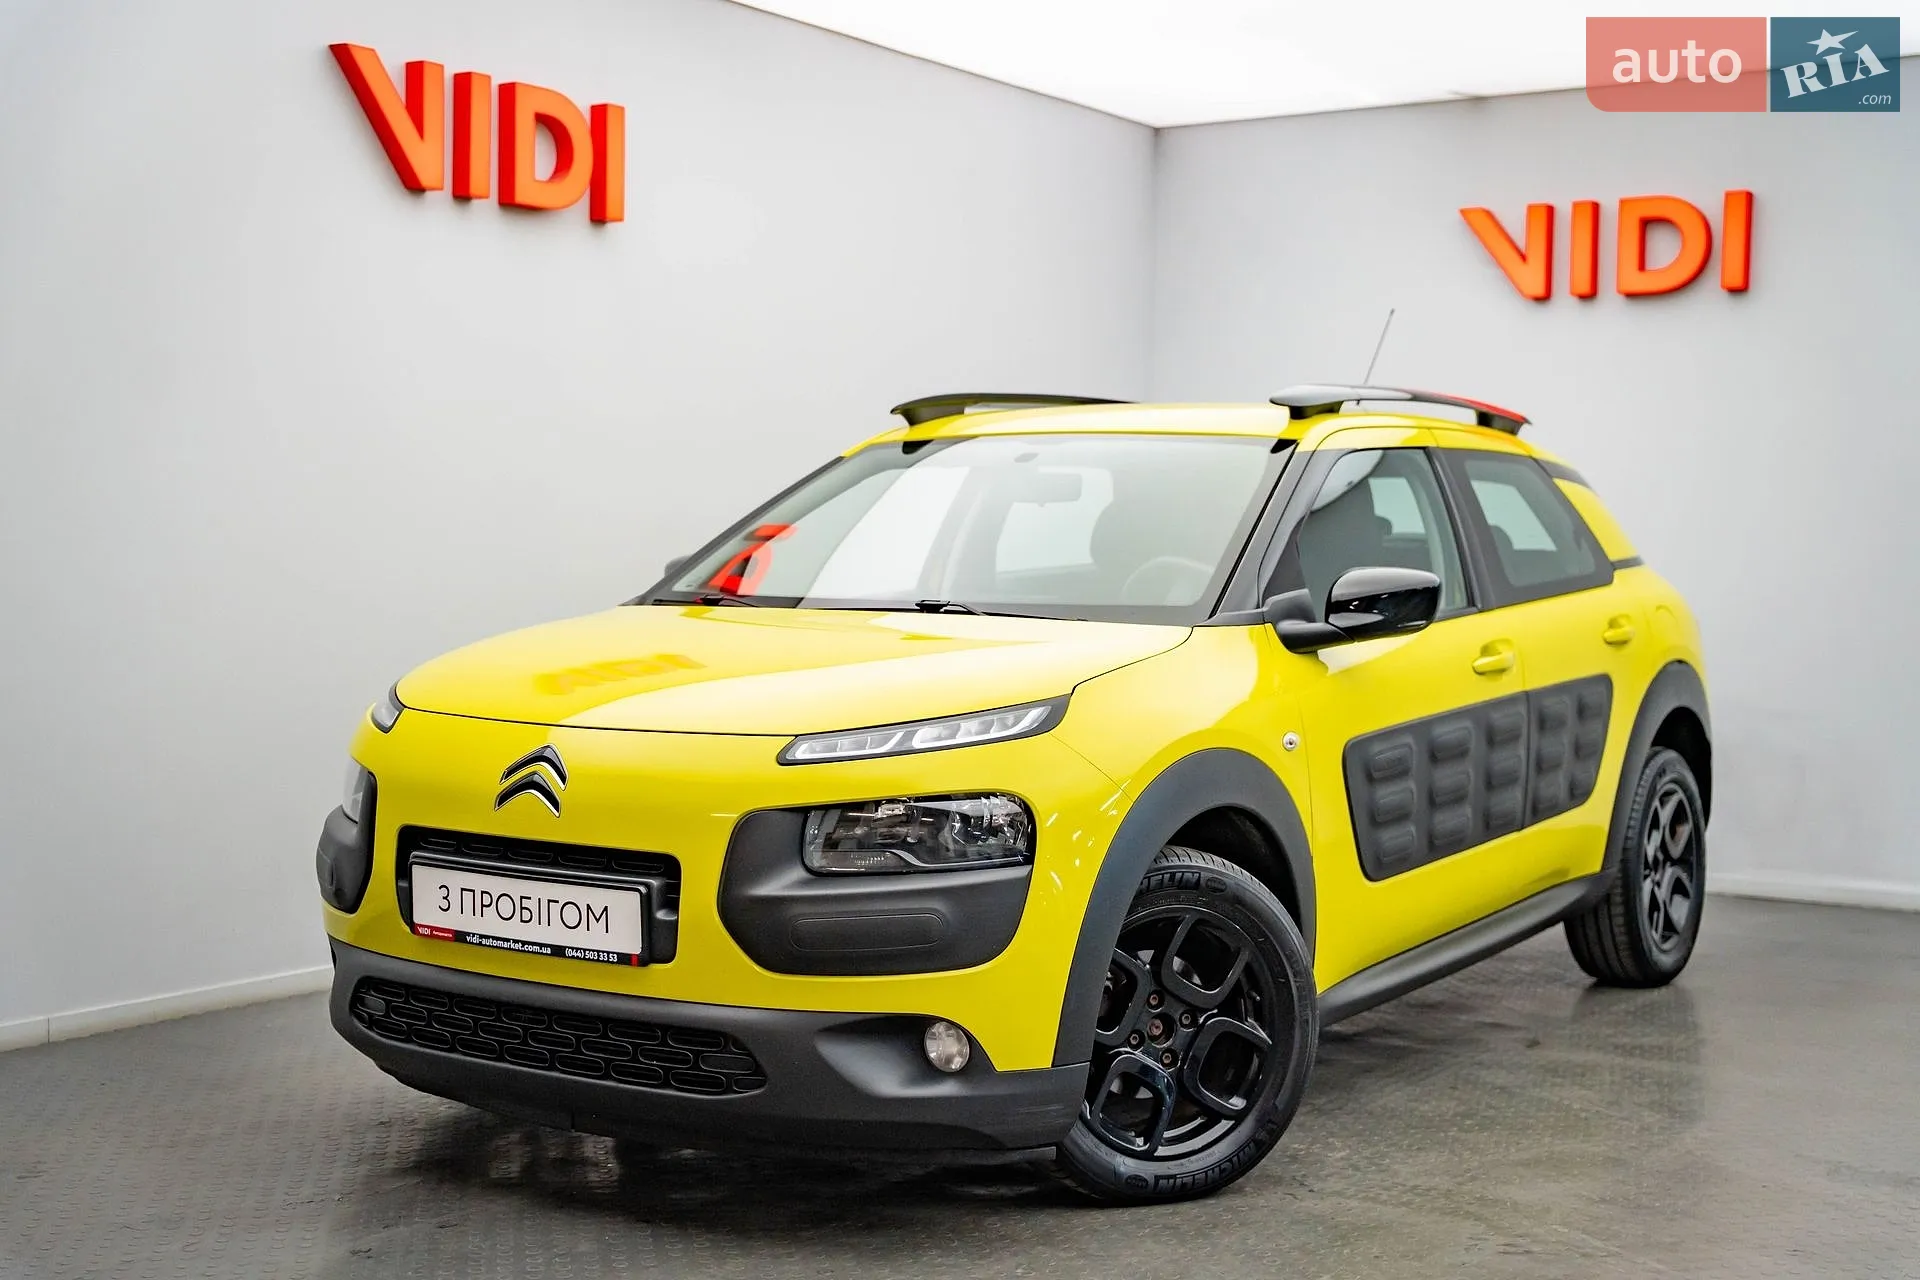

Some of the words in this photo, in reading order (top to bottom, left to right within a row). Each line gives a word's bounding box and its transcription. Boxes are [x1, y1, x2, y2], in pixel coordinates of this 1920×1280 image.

[328, 43, 625, 223] VIDI
[1459, 189, 1753, 300] VIDI
[460, 887, 609, 934] ПРОБІГОМ
[466, 934, 551, 954] vidi-automarket.com.ua
[565, 948, 584, 958] (044)
[585, 951, 598, 959] 503
[608, 953, 618, 962] 53
